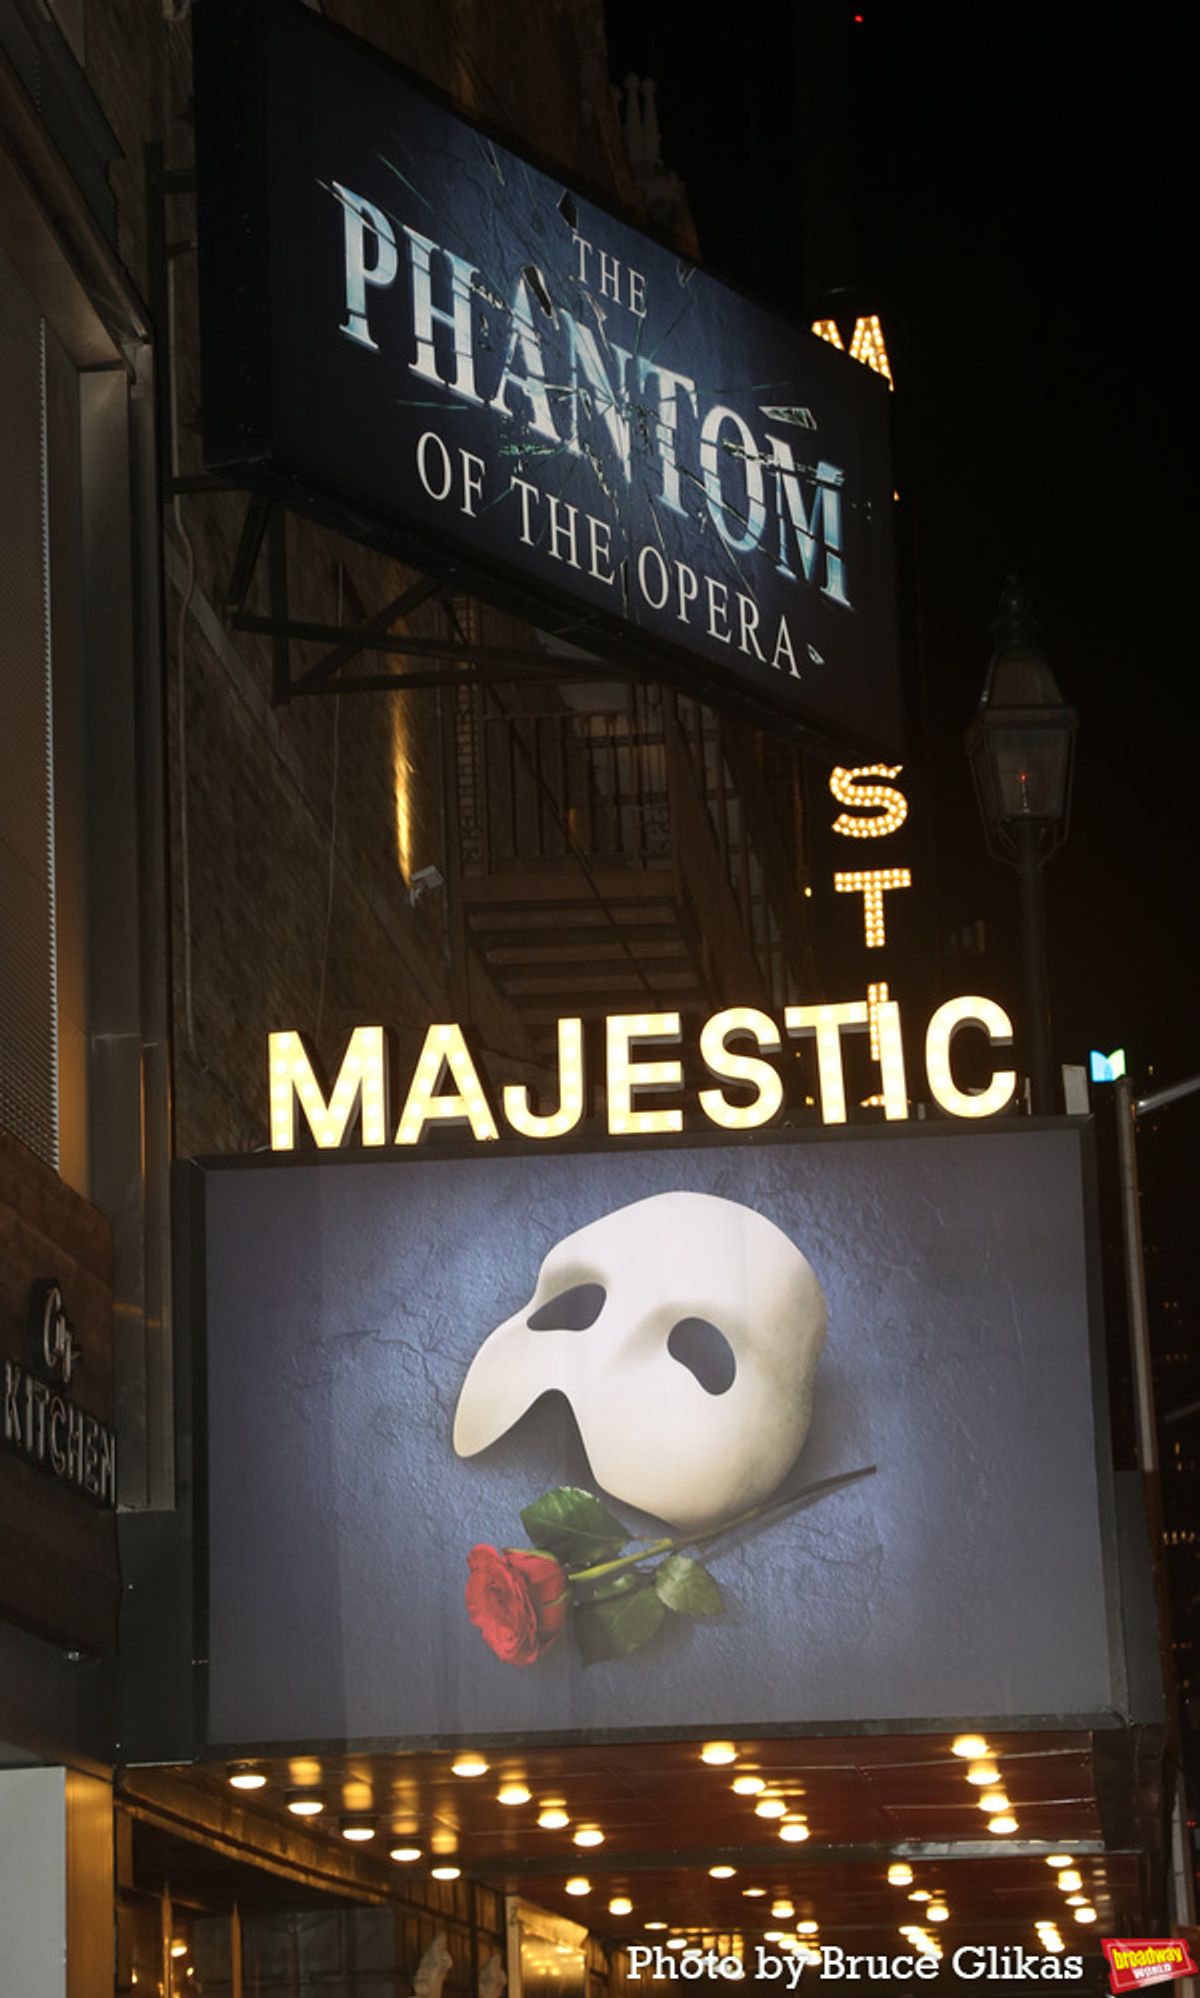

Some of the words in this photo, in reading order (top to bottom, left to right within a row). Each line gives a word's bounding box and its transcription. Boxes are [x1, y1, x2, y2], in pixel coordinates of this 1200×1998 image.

[572, 234, 648, 318] THE
[330, 180, 854, 610] PHANTOM
[416, 432, 486, 516] OF
[509, 476, 616, 586] THE
[637, 545, 802, 680] OPERA
[268, 995, 1018, 1151] MAJESTIC
[4, 1360, 117, 1505] KITCHEN
